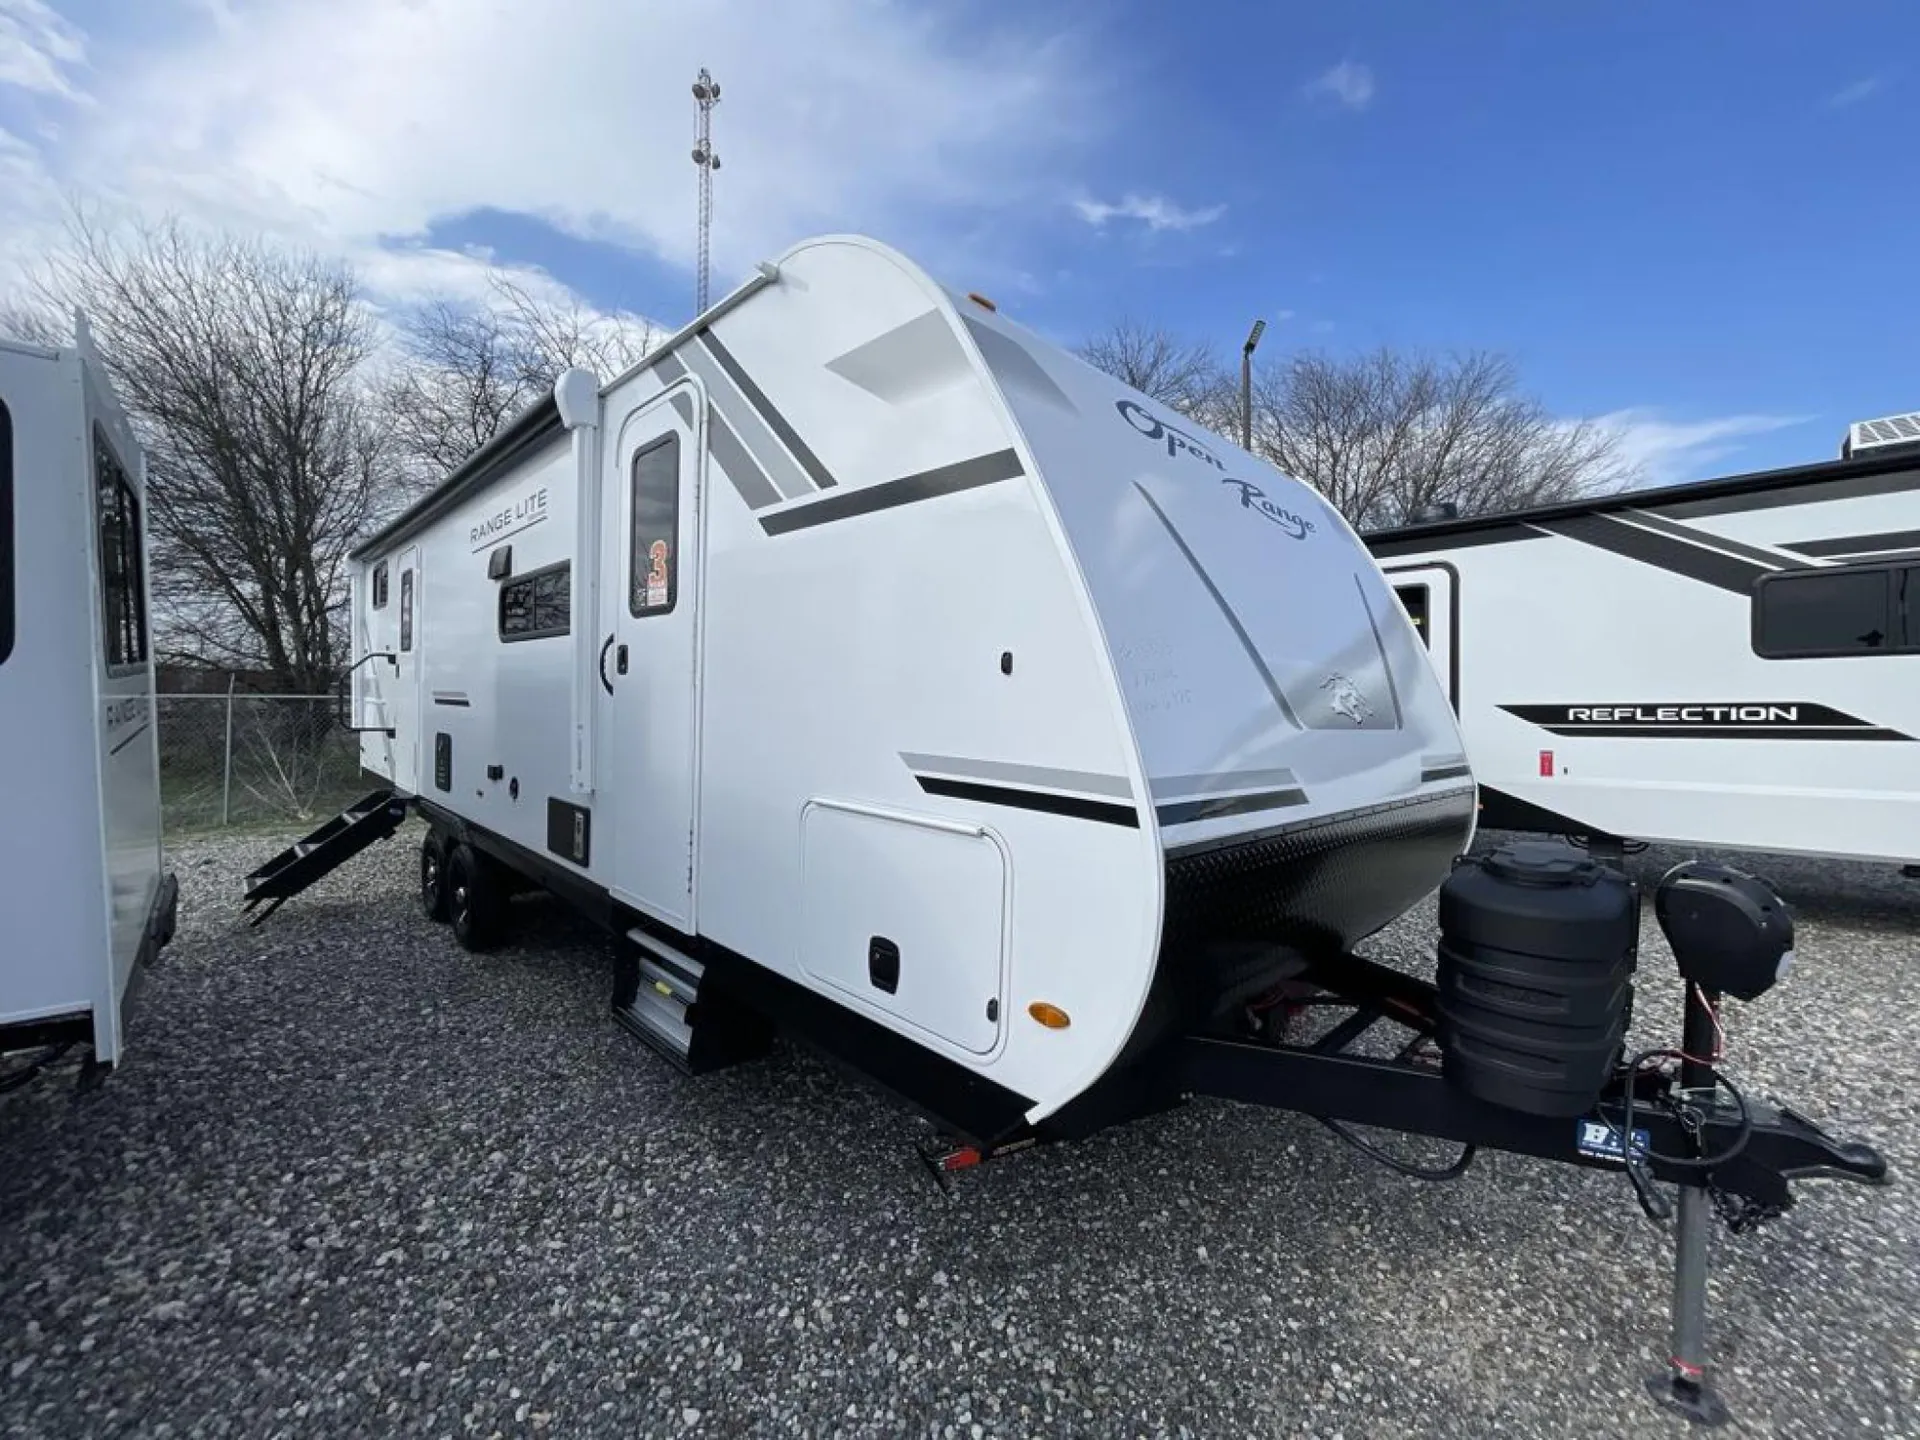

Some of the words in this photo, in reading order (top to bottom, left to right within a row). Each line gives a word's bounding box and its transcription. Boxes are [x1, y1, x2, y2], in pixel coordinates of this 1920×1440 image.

[1115, 400, 1227, 471] Open
[1221, 477, 1317, 540] Range
[470, 508, 512, 543] RANGE
[516, 487, 547, 519] LITE
[648, 539, 668, 587] 3
[1568, 705, 1797, 721] REFLECTION
